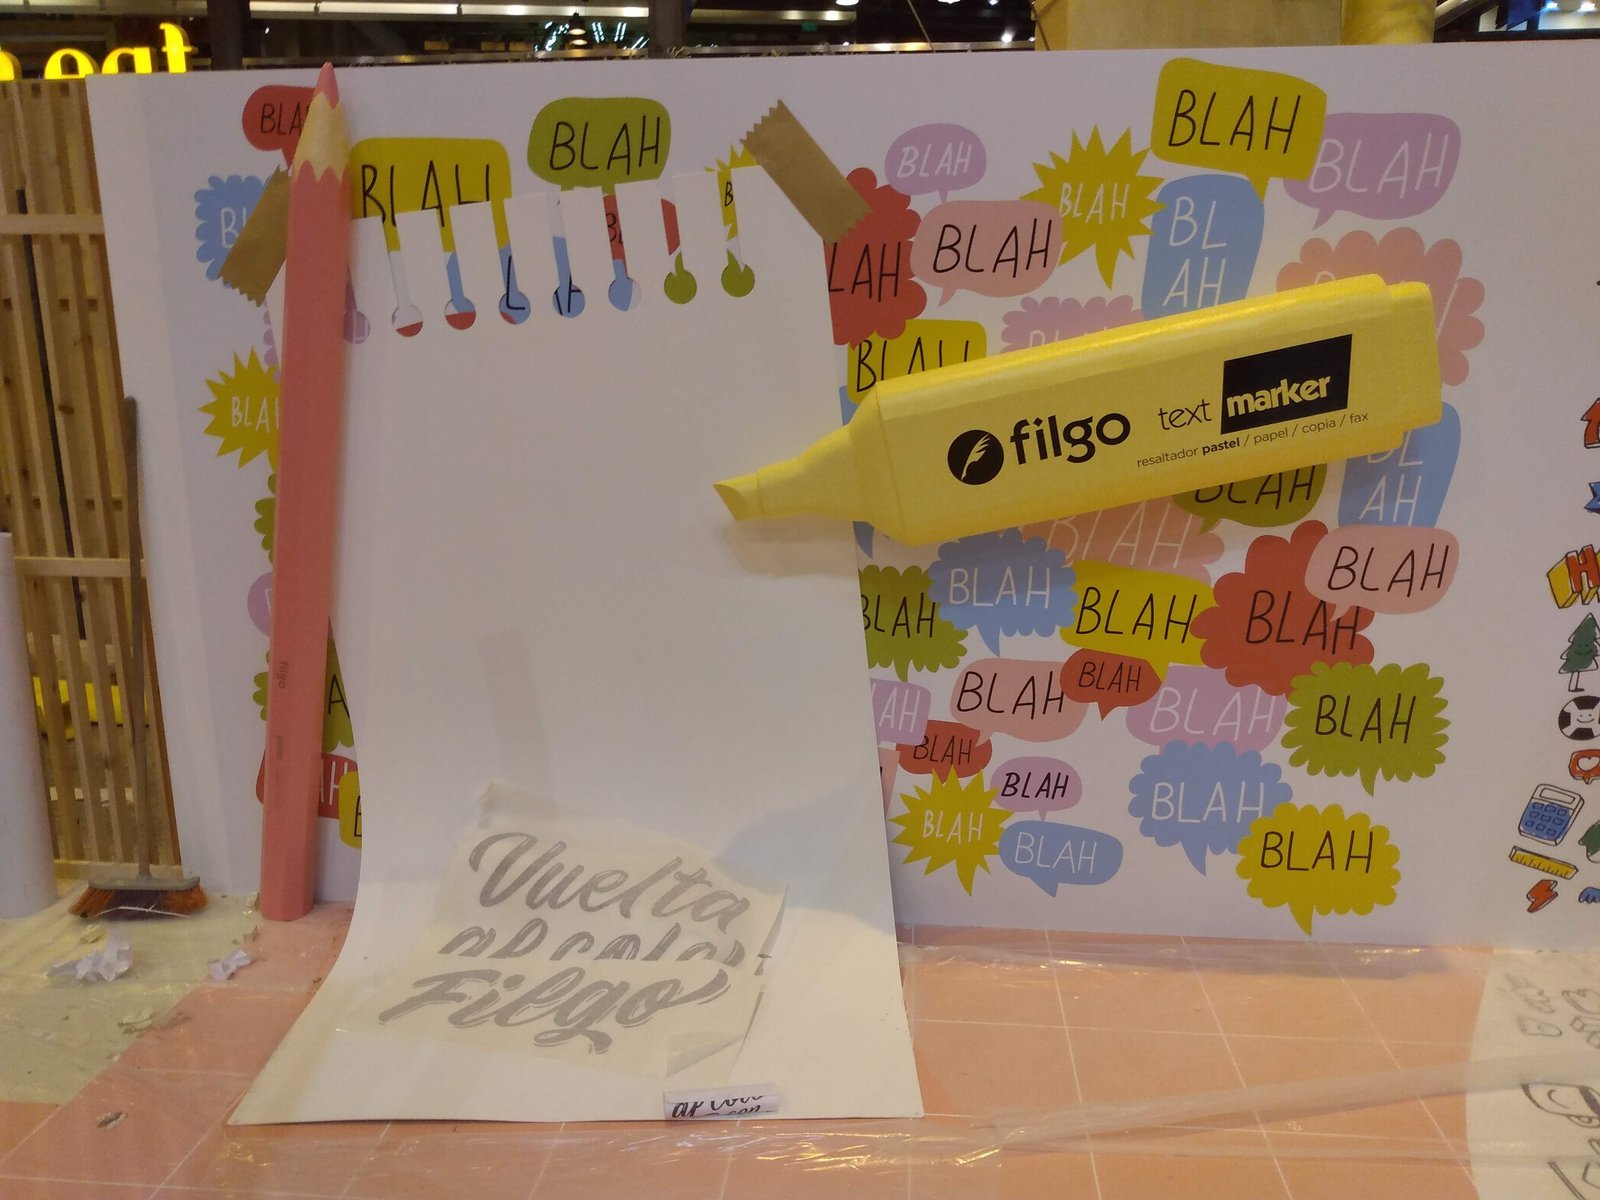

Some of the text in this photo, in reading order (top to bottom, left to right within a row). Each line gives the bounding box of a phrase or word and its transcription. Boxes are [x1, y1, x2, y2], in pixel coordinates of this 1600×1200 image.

[260, 101, 310, 136] BLA
[1168, 89, 1301, 154] BLAH
[549, 114, 661, 175] BLAH
[897, 141, 972, 178] BLAH
[1309, 131, 1449, 199] BLAH
[1059, 182, 1130, 225] BLAH
[828, 241, 901, 302] LAH
[933, 218, 1052, 278] BLAH
[1158, 376, 1331, 431] text marker
[1010, 412, 1131, 464] filgo
[1137, 447, 1199, 468] resaltador
[1202, 437, 1241, 456] pastel
[1253, 427, 1289, 446] papel
[1301, 418, 1336, 437] copia
[1349, 411, 1369, 424] fax
[950, 566, 1050, 608] BLAH
[1327, 543, 1449, 598] BLAH
[1075, 586, 1197, 643] BLAH
[1246, 590, 1360, 655] BLAH
[957, 671, 1064, 720] BLAH
[1078, 661, 1141, 694] BLAH
[873, 684, 921, 733] AH
[1150, 686, 1275, 741] BLAH
[1315, 693, 1416, 744] BLAH
[912, 735, 972, 765] BLAH
[1001, 772, 1069, 800] BLAH
[1151, 781, 1264, 824] BLAH
[923, 810, 983, 844] BLAH
[1261, 831, 1374, 873] BLAH
[1014, 832, 1097, 874] BLAH
[468, 832, 751, 934] Vuelta
[378, 966, 731, 1054] Filgo
